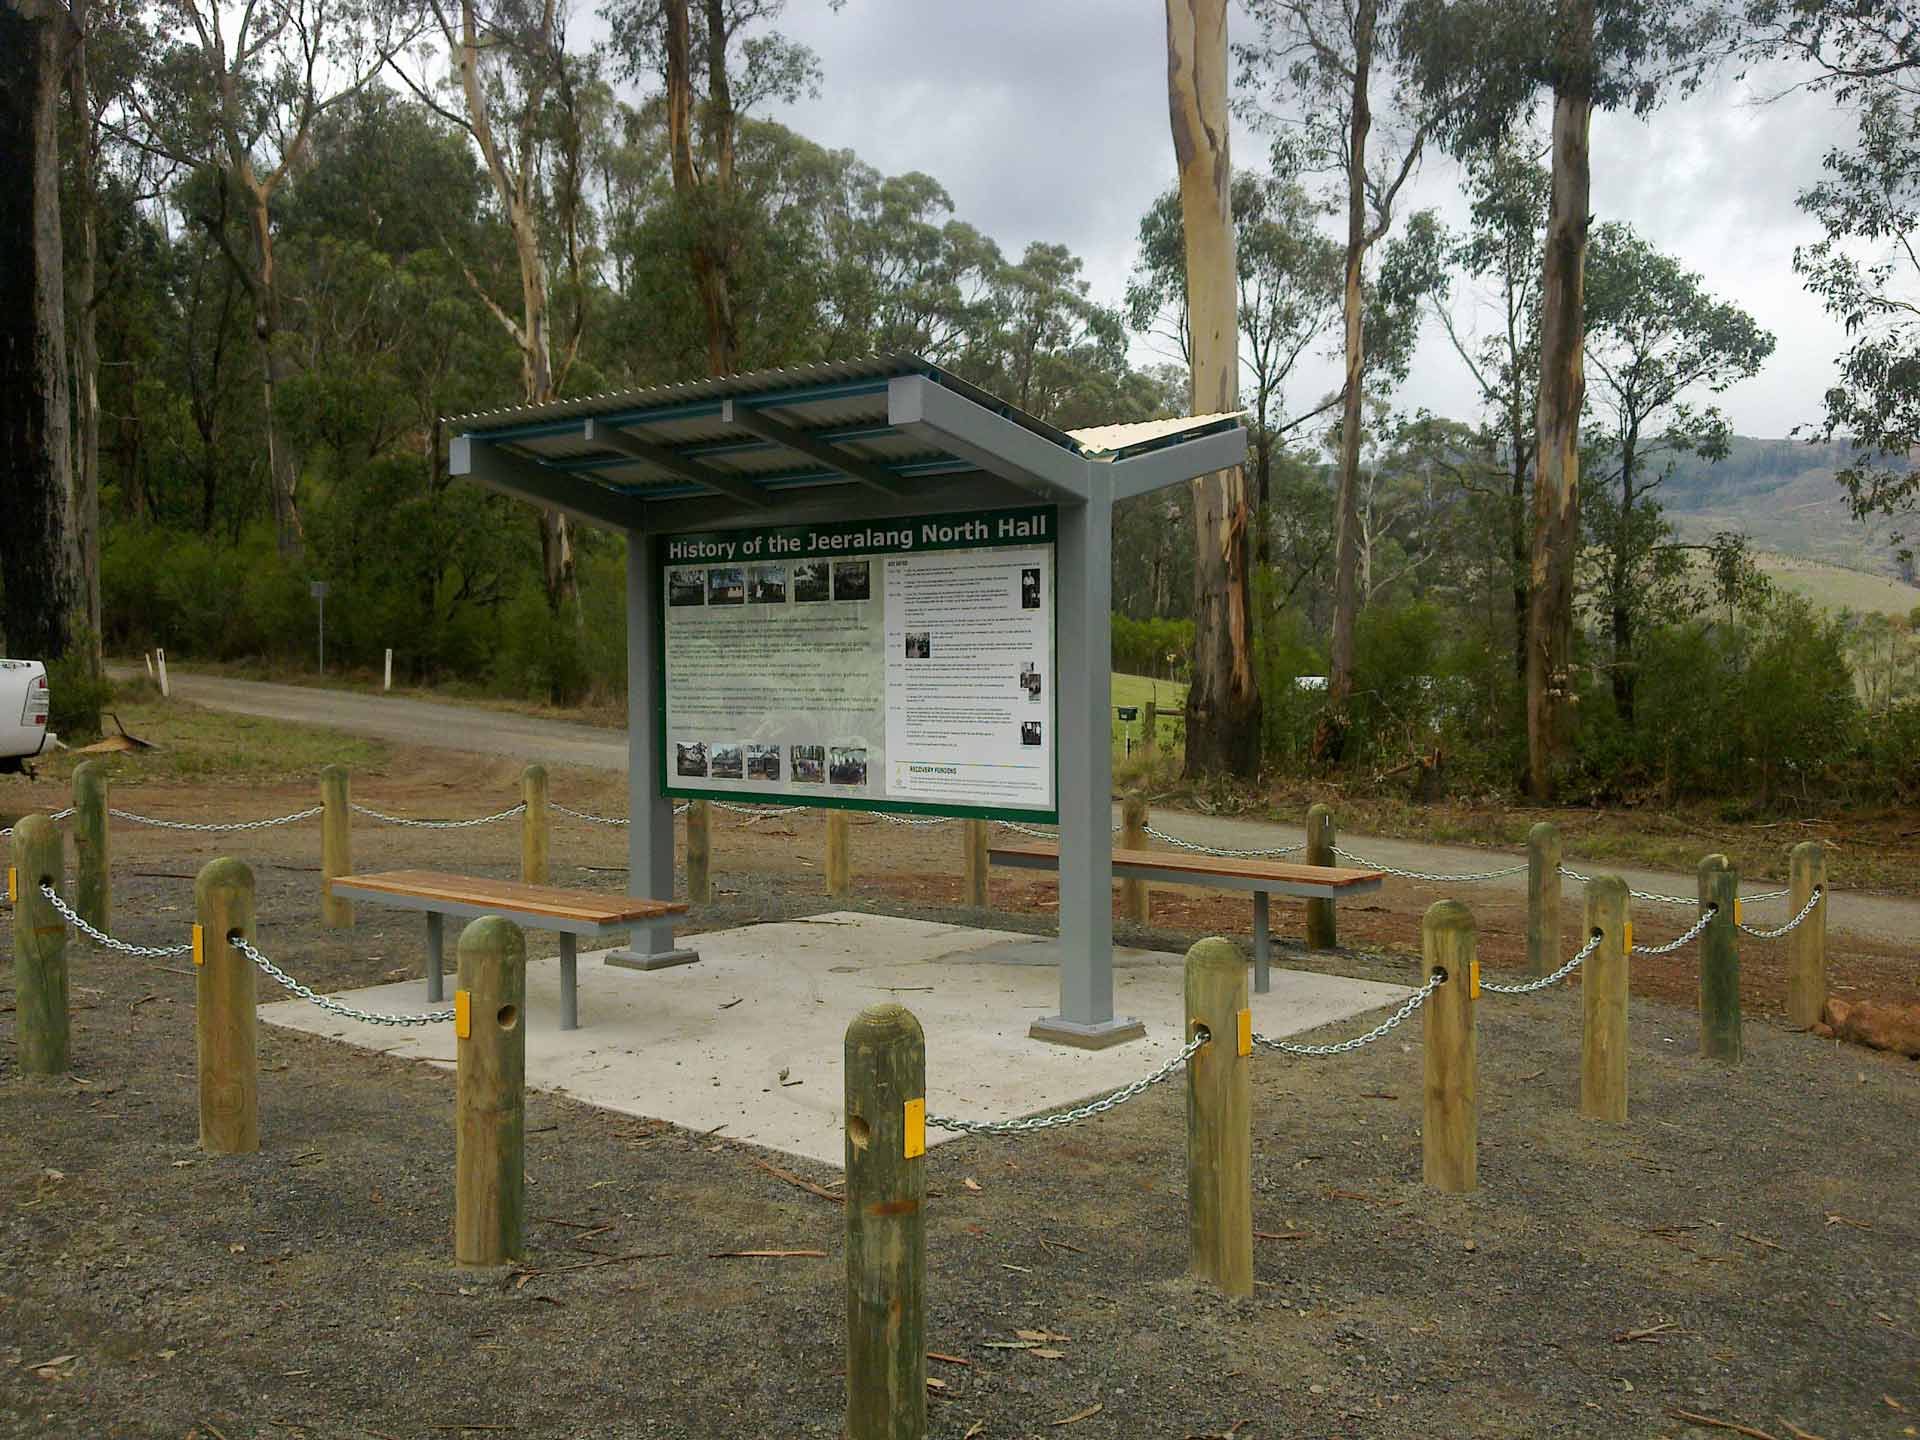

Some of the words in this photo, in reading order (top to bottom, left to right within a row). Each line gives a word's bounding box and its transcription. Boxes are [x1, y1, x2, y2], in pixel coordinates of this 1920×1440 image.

[669, 541, 737, 559] History
[742, 536, 763, 554] of
[768, 533, 801, 553] the
[807, 528, 913, 550] Jeeralang
[922, 520, 989, 543] North
[998, 515, 1047, 537] Hall
